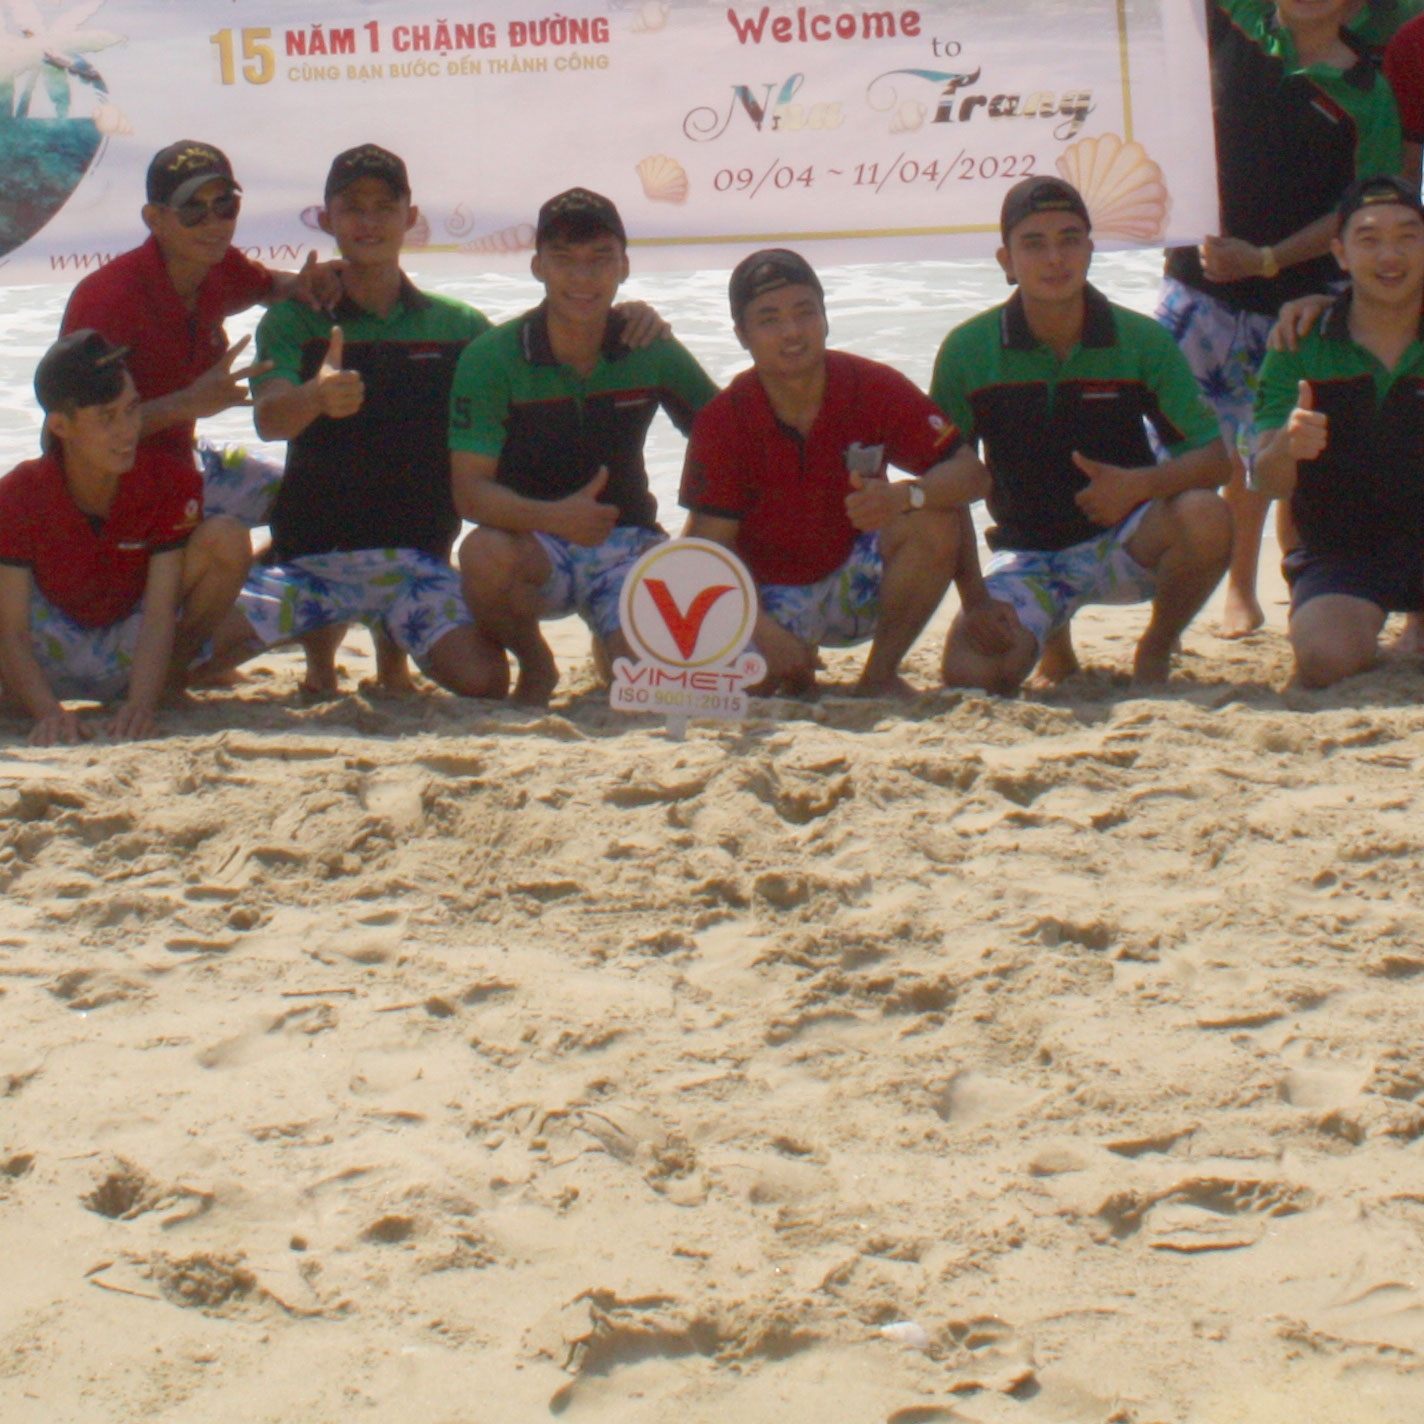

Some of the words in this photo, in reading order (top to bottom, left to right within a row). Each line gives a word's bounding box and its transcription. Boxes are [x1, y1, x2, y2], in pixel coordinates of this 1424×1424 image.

[727, 6, 922, 45] Welcome
[209, 27, 276, 85] 15
[285, 23, 356, 56] NĂM
[364, 20, 380, 53] 1
[392, 18, 497, 56] CHẶNG
[507, 12, 610, 48] ĐƯỜNG
[931, 37, 963, 58] to
[288, 62, 340, 82] CÙNG
[347, 62, 384, 84] BẠN
[488, 51, 548, 73] THÀNH
[554, 51, 610, 71] CÔNG
[867, 66, 1096, 141] Trang
[713, 158, 815, 199] 09/04
[853, 148, 1036, 194] 11/04/2022
[621, 665, 744, 693] VIMET
[618, 687, 649, 703] ISO
[654, 690, 741, 712] 9001:2015
